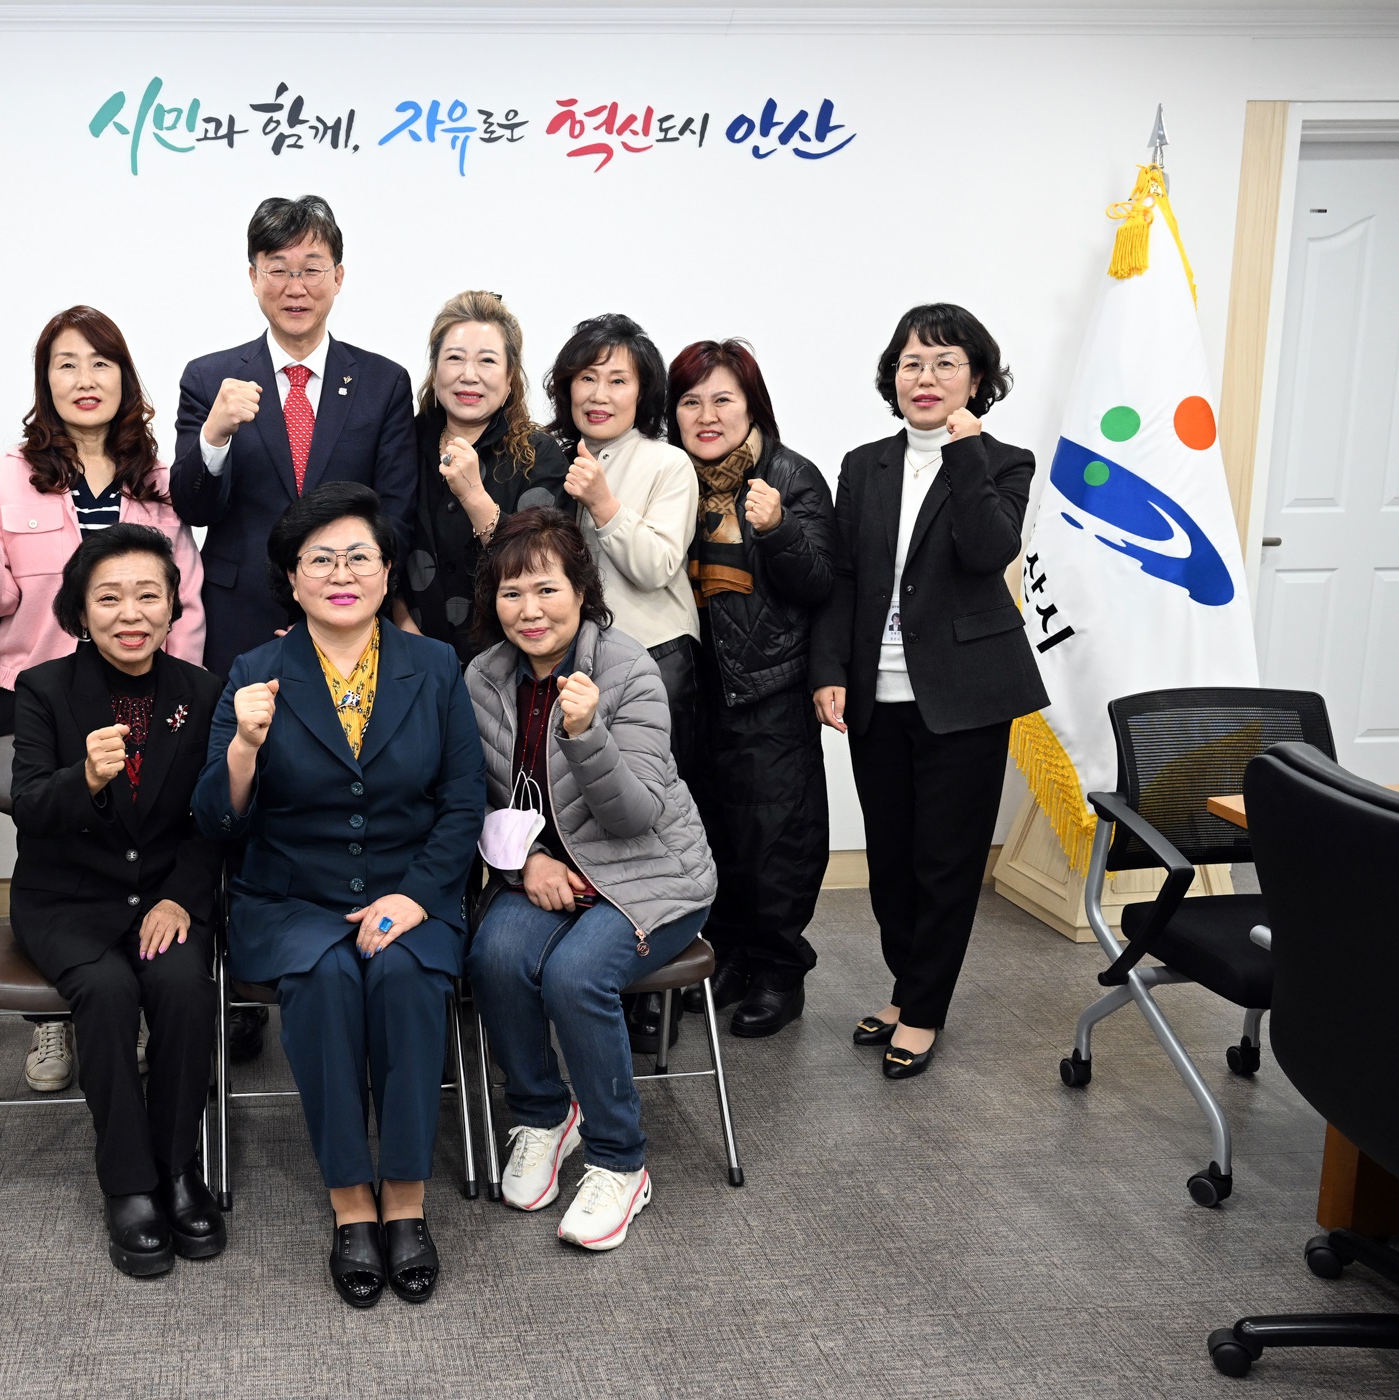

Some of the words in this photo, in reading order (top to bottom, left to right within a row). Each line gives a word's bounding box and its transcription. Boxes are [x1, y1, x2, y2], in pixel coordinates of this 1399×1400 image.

[88, 75, 250, 177] 시민과
[248, 81, 361, 158] 함께,
[377, 98, 530, 178] 자유로운
[545, 97, 711, 174] 혁신도시
[724, 96, 859, 161] 안산
